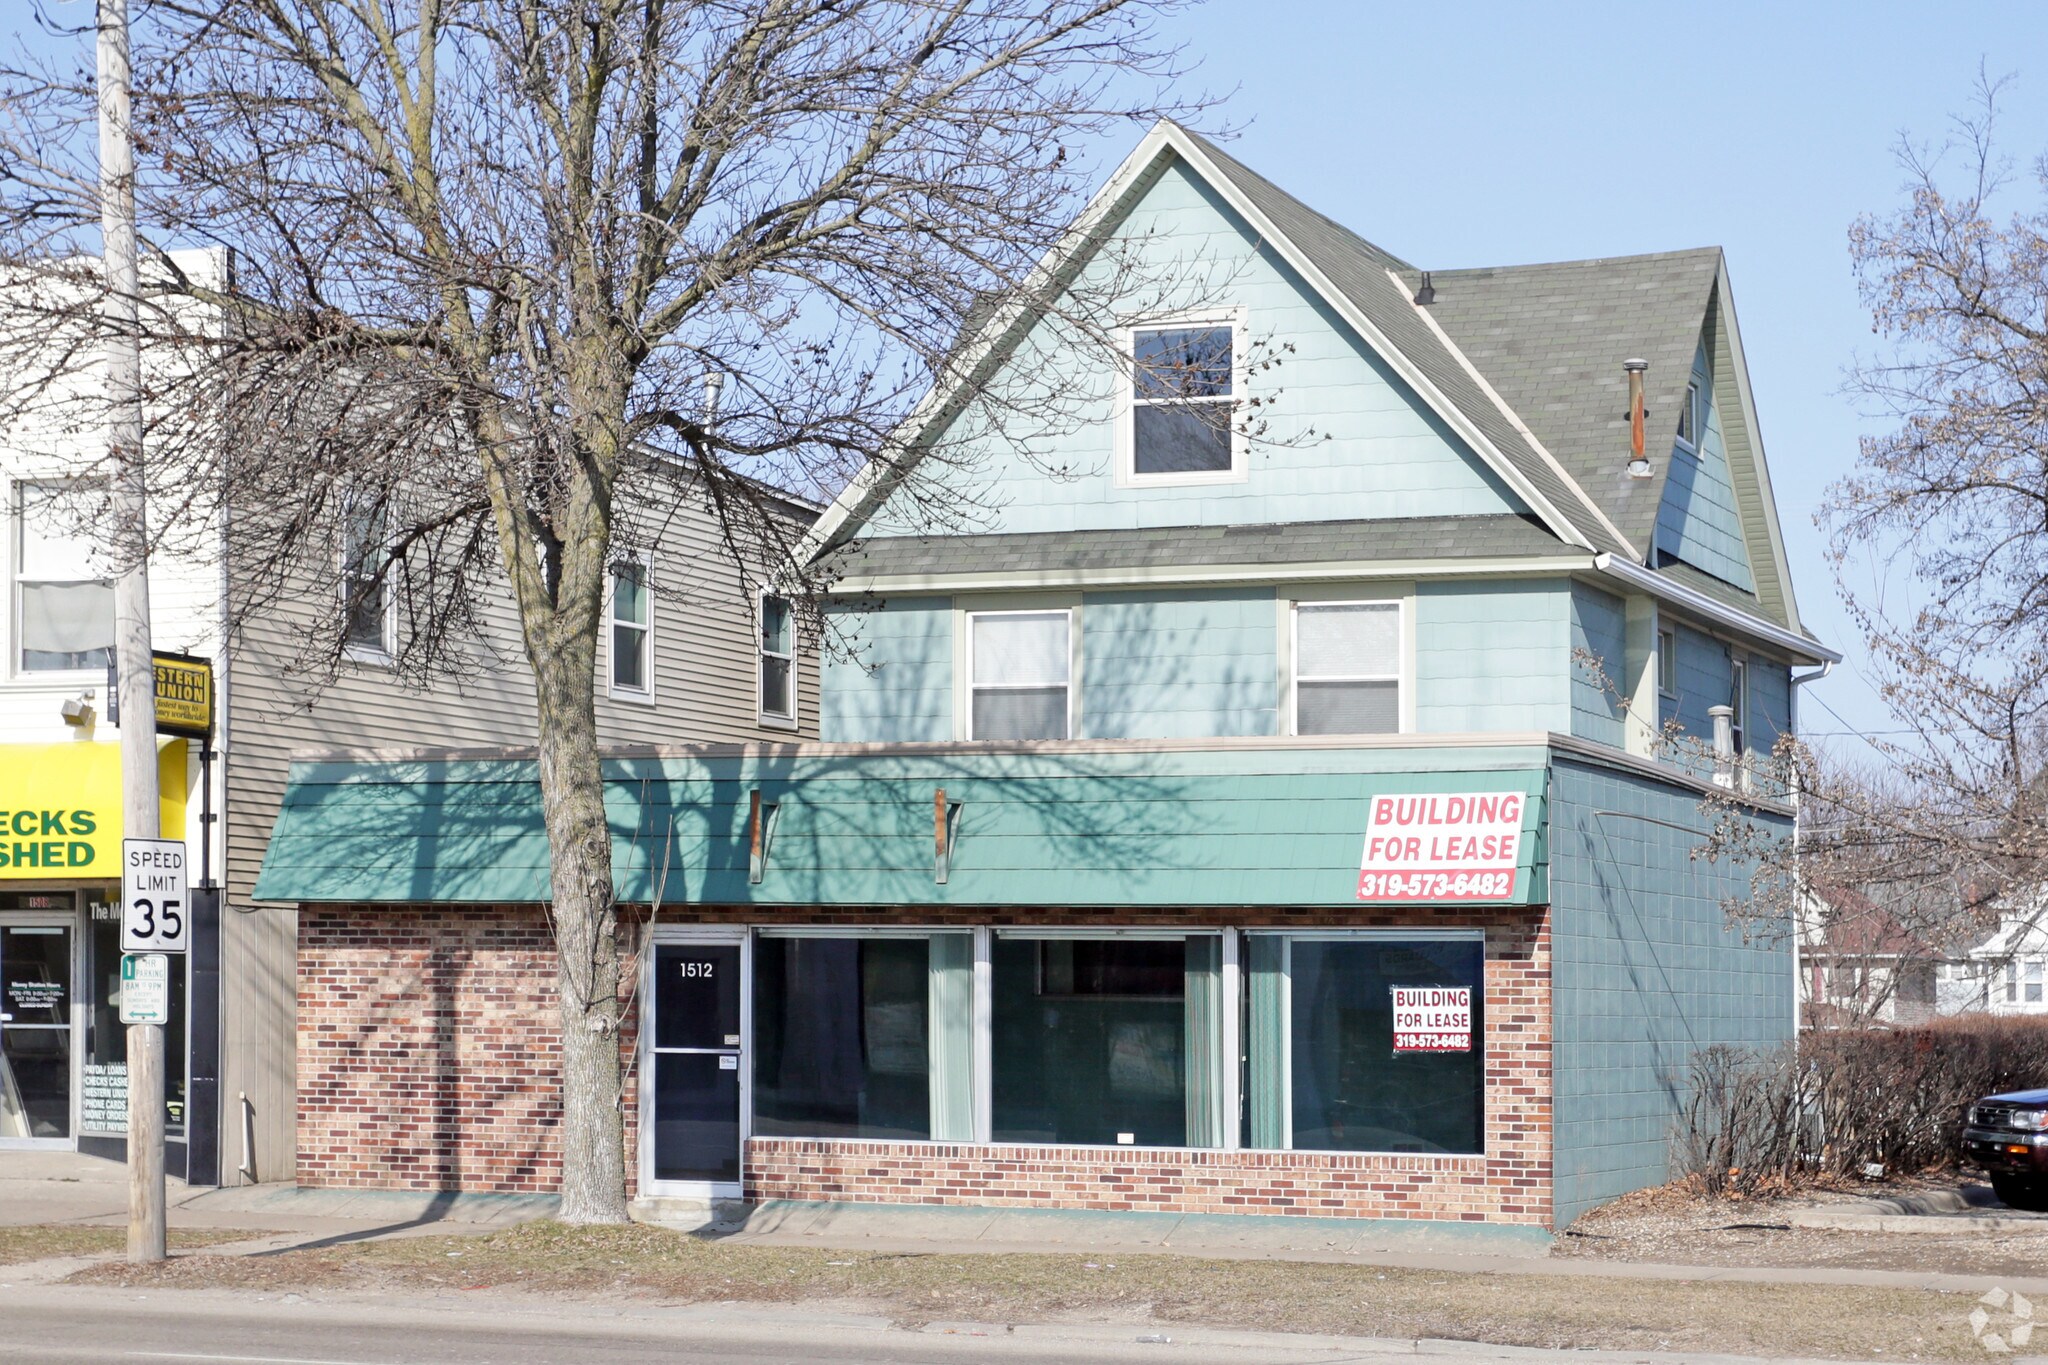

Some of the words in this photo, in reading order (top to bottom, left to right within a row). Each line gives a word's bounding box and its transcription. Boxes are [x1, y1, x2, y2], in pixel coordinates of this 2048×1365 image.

[152, 666, 204, 688] ESTERN
[157, 683, 204, 702] UNION
[1374, 795, 1520, 826] BUILDING
[1368, 836, 1422, 862] FOR
[1430, 835, 1516, 861] LEASE
[130, 851, 182, 869] SPEED
[137, 876, 177, 892] LIMIT
[1361, 872, 1510, 897] 319-573-6482
[90, 902, 108, 920] The
[131, 898, 182, 940] 35
[126, 959, 132, 977] 1
[146, 959, 157, 968] HR
[135, 969, 164, 978] PARKING
[680, 962, 713, 978] 1512
[125, 982, 140, 991] 8AM
[1396, 991, 1469, 1007] BUILDING
[1396, 1013, 1422, 1028] FOR
[1427, 1013, 1469, 1028] LEASE
[1395, 1034, 1470, 1048] 319-573-6482
[107, 1065, 127, 1076] LOANS
[85, 1075, 109, 1087] CHECKS
[109, 1076, 128, 1088] CASHE
[85, 1086, 112, 1098] WESTERN
[112, 1087, 128, 1099] UNIO
[85, 1098, 105, 1109] PHONE
[105, 1099, 126, 1110] CARDS
[85, 1109, 106, 1120] MONEY
[85, 1120, 106, 1131] UTILITY
[106, 1121, 129, 1132] PAYME
